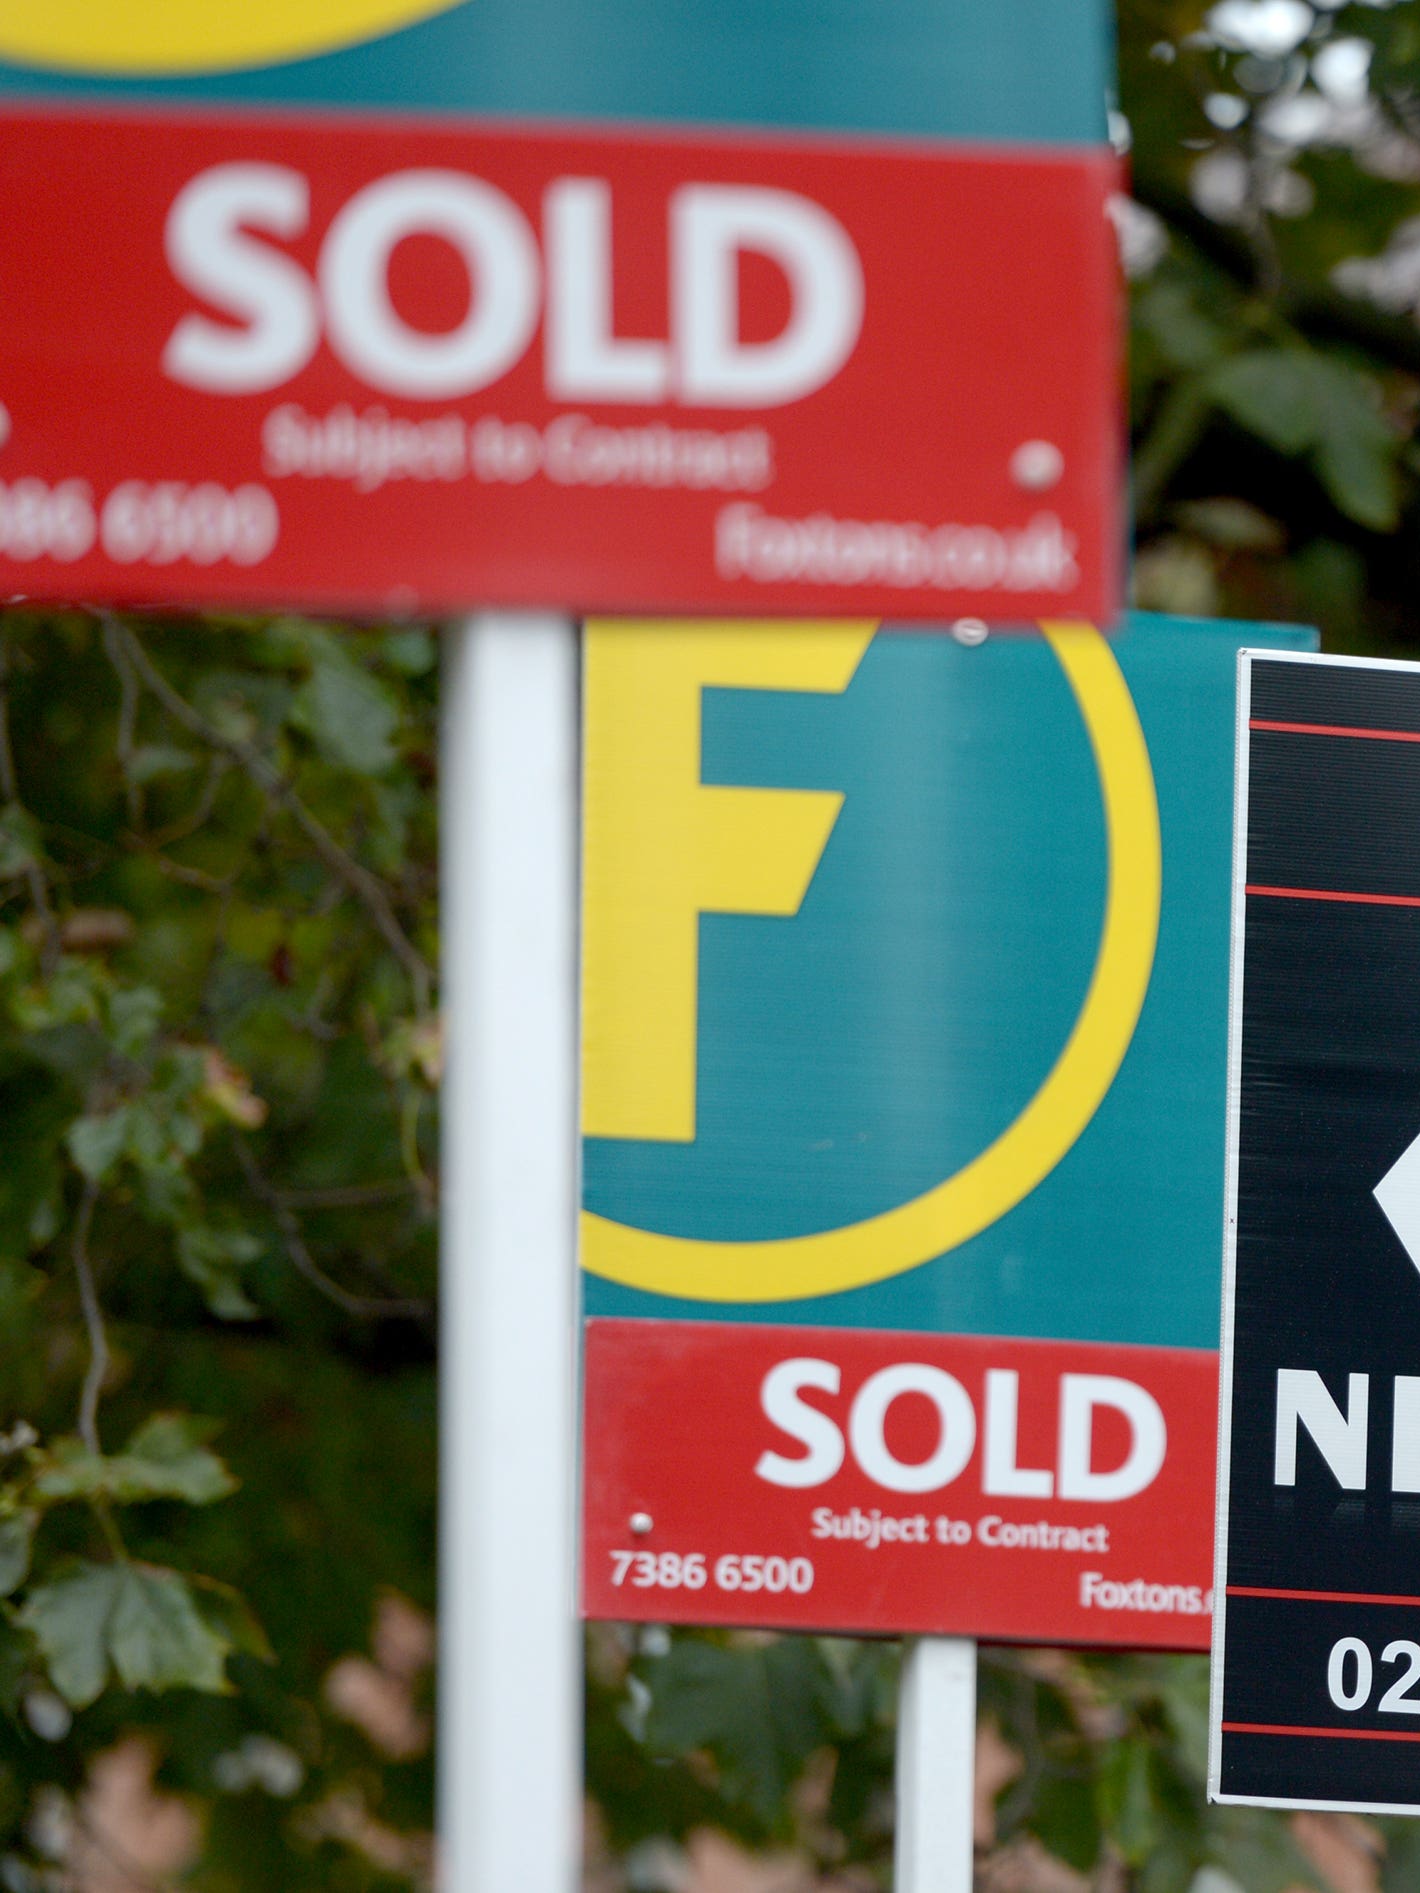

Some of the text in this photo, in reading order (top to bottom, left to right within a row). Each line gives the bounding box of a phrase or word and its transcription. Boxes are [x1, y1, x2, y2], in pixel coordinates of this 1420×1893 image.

[162, 159, 866, 409] SOLD
[262, 403, 775, 494] Subject to Contract
[0, 476, 98, 563] 86
[755, 1357, 1167, 1503] SOLD
[610, 1550, 814, 1594] 7386 6500
[811, 1507, 1109, 1553] Subject to Contract
